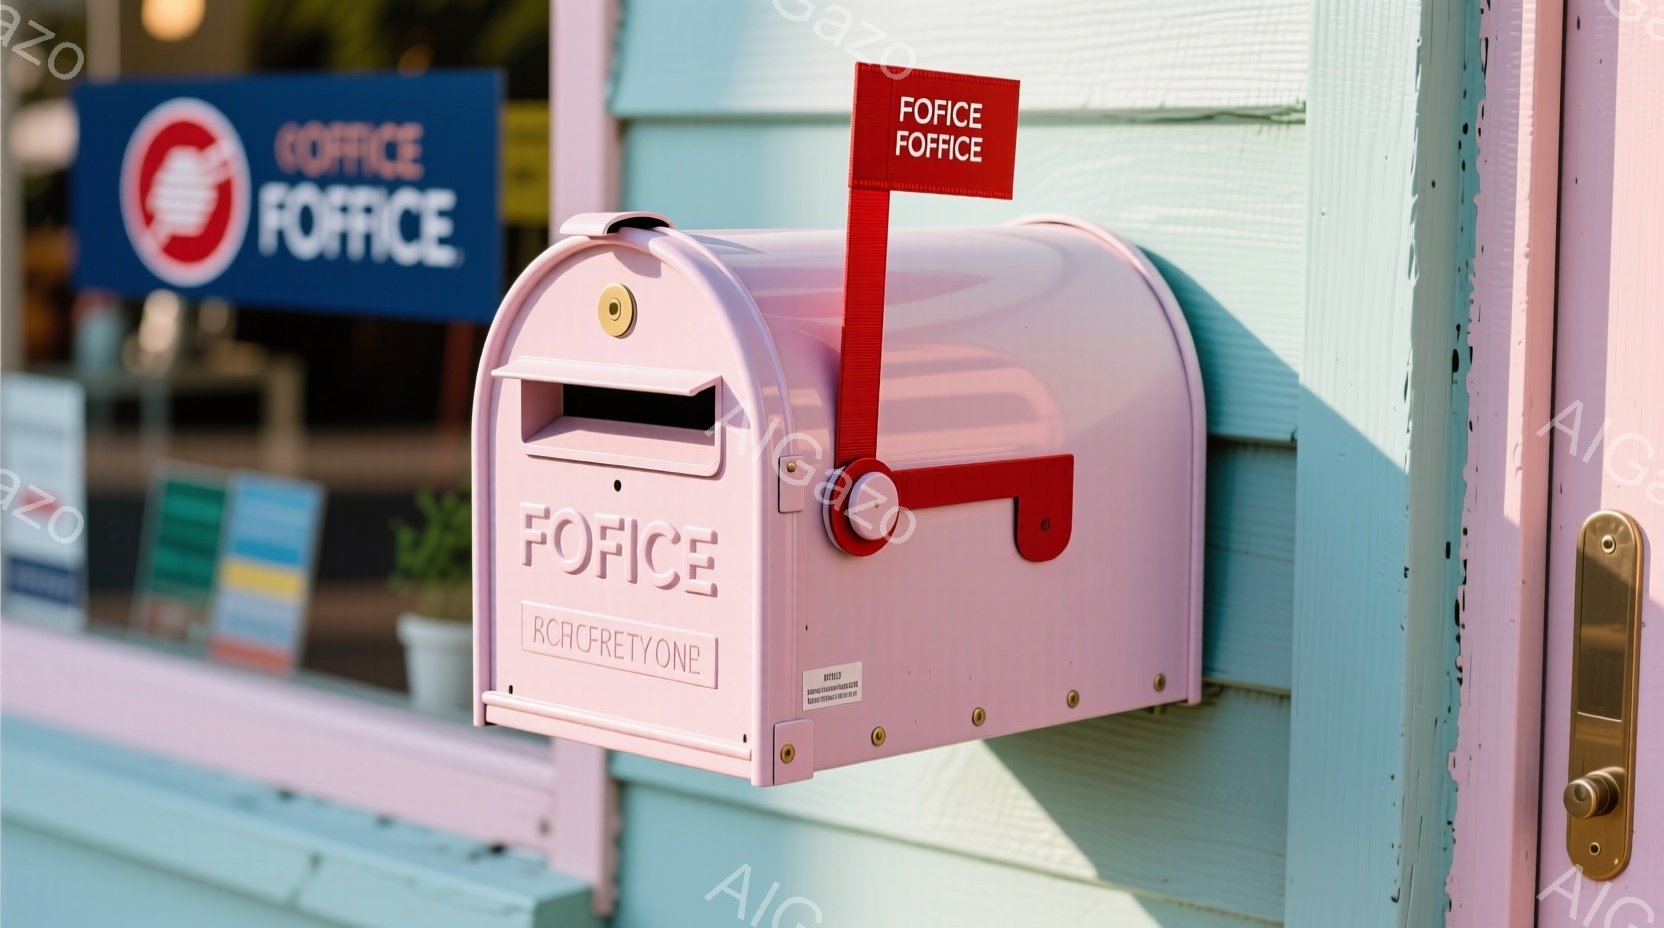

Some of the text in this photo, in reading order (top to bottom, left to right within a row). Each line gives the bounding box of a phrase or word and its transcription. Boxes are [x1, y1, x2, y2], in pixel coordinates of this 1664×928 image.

[899, 96, 983, 129] FOFICE
[895, 130, 984, 163] FOFFICE
[521, 502, 719, 598] FOFICE
